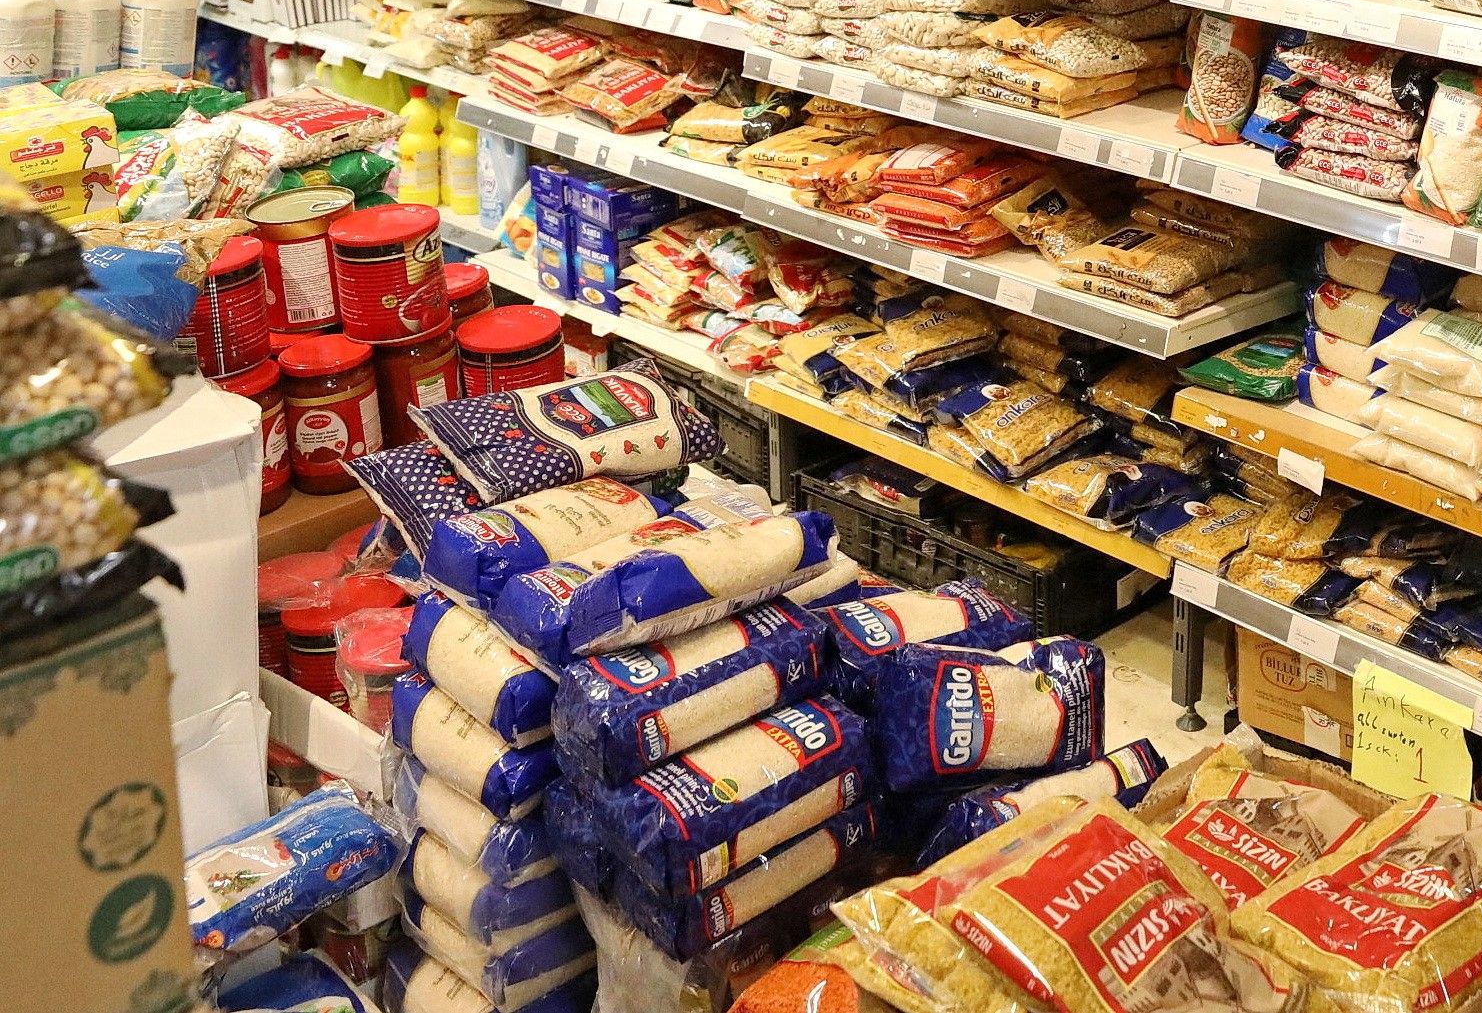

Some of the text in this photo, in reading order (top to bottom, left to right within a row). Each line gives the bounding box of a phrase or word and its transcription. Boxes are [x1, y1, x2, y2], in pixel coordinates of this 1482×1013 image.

[560, 402, 591, 425] ECE
[1200, 508, 1250, 535] ankara
[975, 669, 994, 717] EXTRA
[1274, 671, 1296, 687] TUZ
[646, 717, 661, 762] Garrido
[943, 667, 972, 767] Garrido
[767, 726, 804, 759] EXTRA
[1043, 838, 1154, 931] BAKLIYAT
[708, 895, 723, 942] Garrido
[1304, 877, 1428, 947] BAKLIYAT
